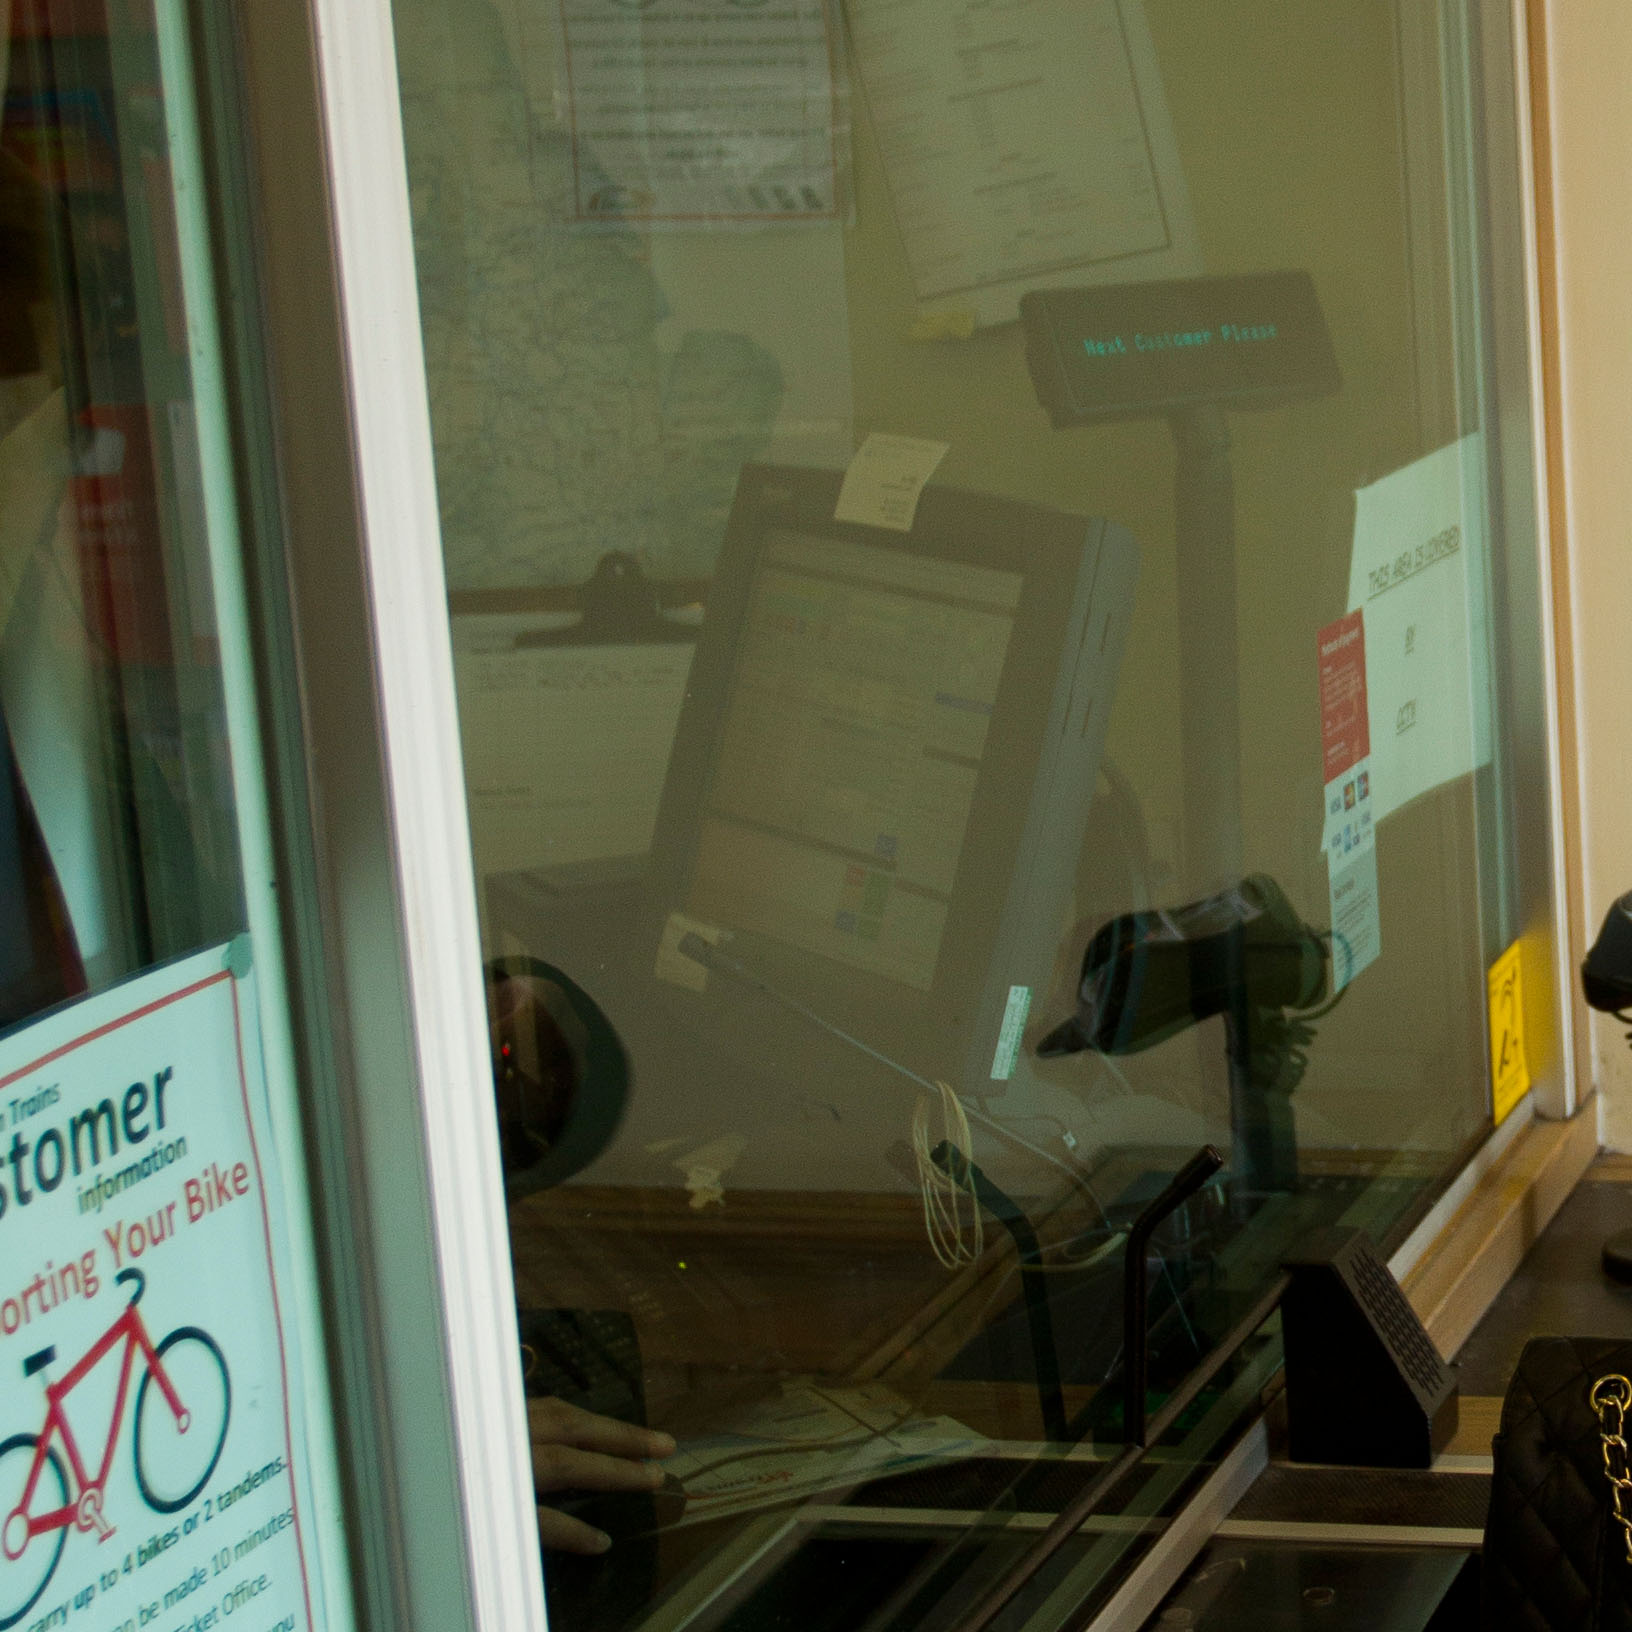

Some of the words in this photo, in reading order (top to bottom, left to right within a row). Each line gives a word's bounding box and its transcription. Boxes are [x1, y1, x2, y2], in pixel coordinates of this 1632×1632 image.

[1369, 563, 1390, 594] THIS
[1425, 524, 1460, 563] COVERED
[8, 1083, 60, 1126] Trains
[77, 1136, 189, 1215] information
[104, 1200, 177, 1269] Your
[184, 1161, 251, 1225] Bike
[73, 1583, 97, 1612] up
[100, 1568, 119, 1594] to
[122, 1552, 134, 1575] 4
[136, 1526, 182, 1568] bikes
[182, 1512, 202, 1536] or
[203, 1498, 214, 1524] 2
[138, 1599, 160, 1628] be
[163, 1566, 209, 1611] made
[211, 1546, 232, 1579] 10
[233, 1506, 296, 1562] minutes
